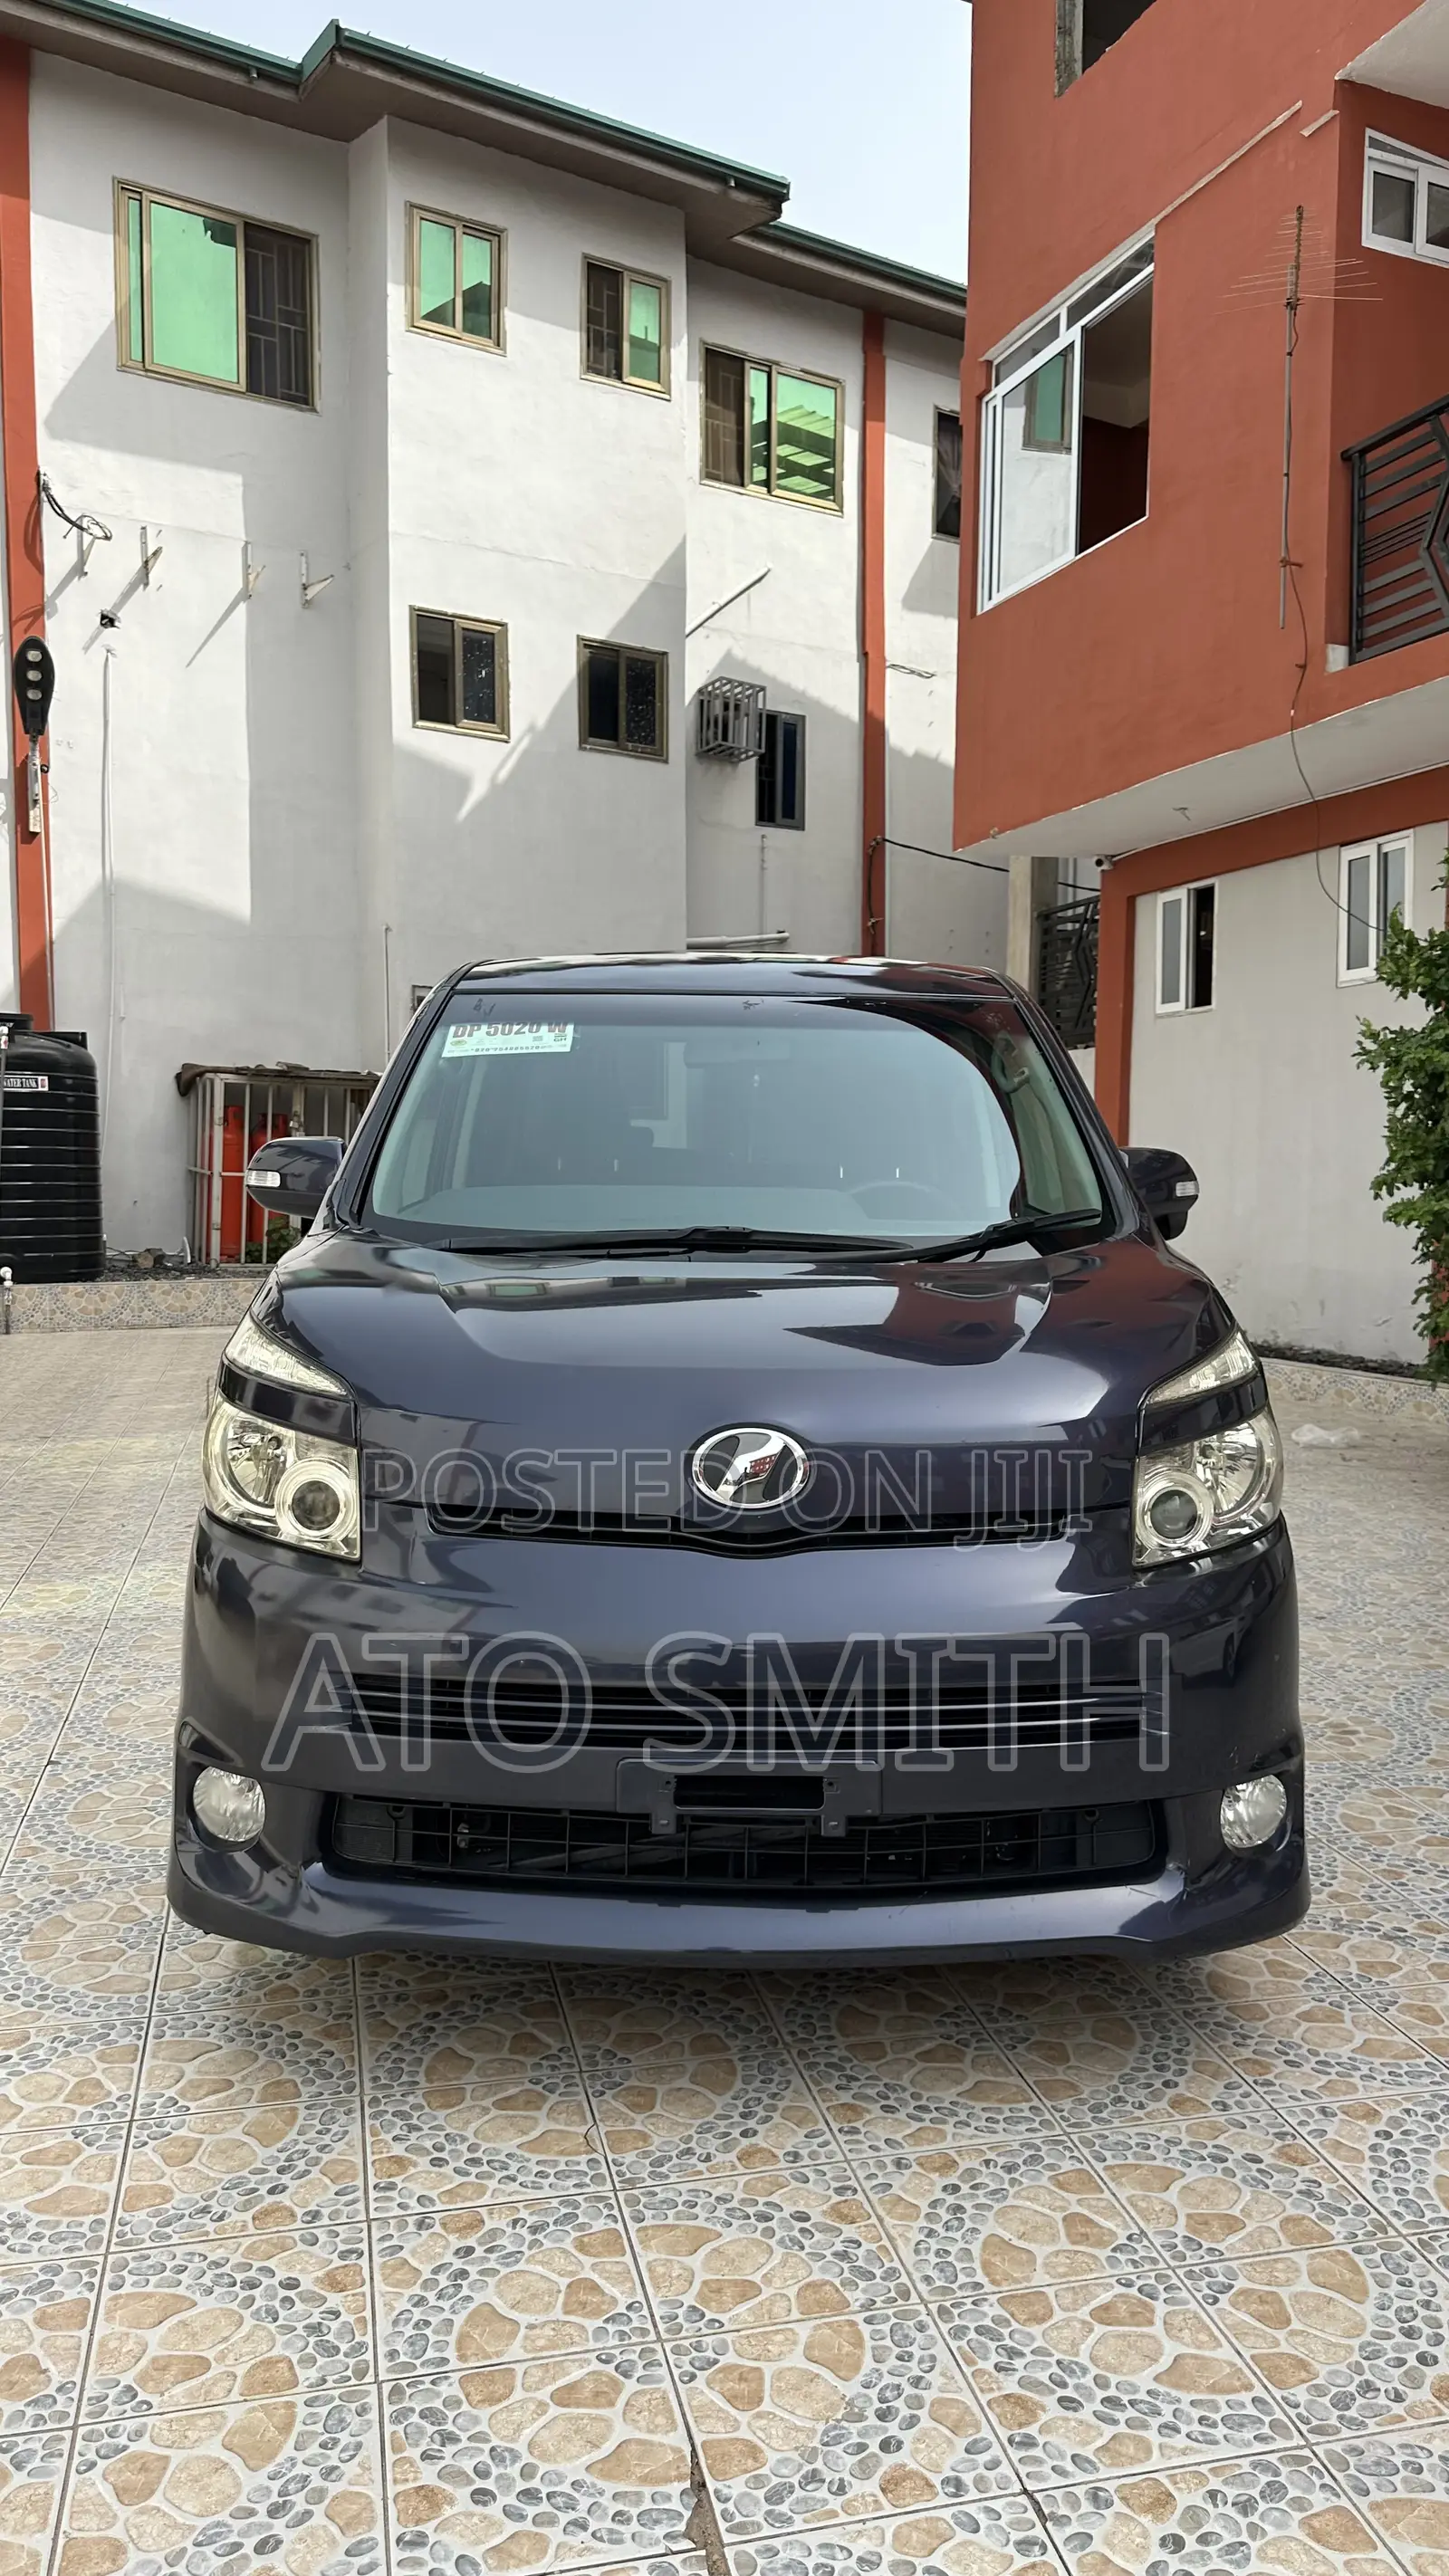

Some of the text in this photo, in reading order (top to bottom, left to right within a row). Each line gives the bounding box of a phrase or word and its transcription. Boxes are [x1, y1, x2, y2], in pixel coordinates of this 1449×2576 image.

[453, 1021, 568, 1038] DP 5020 W
[22, 1077, 38, 1087] TANK
